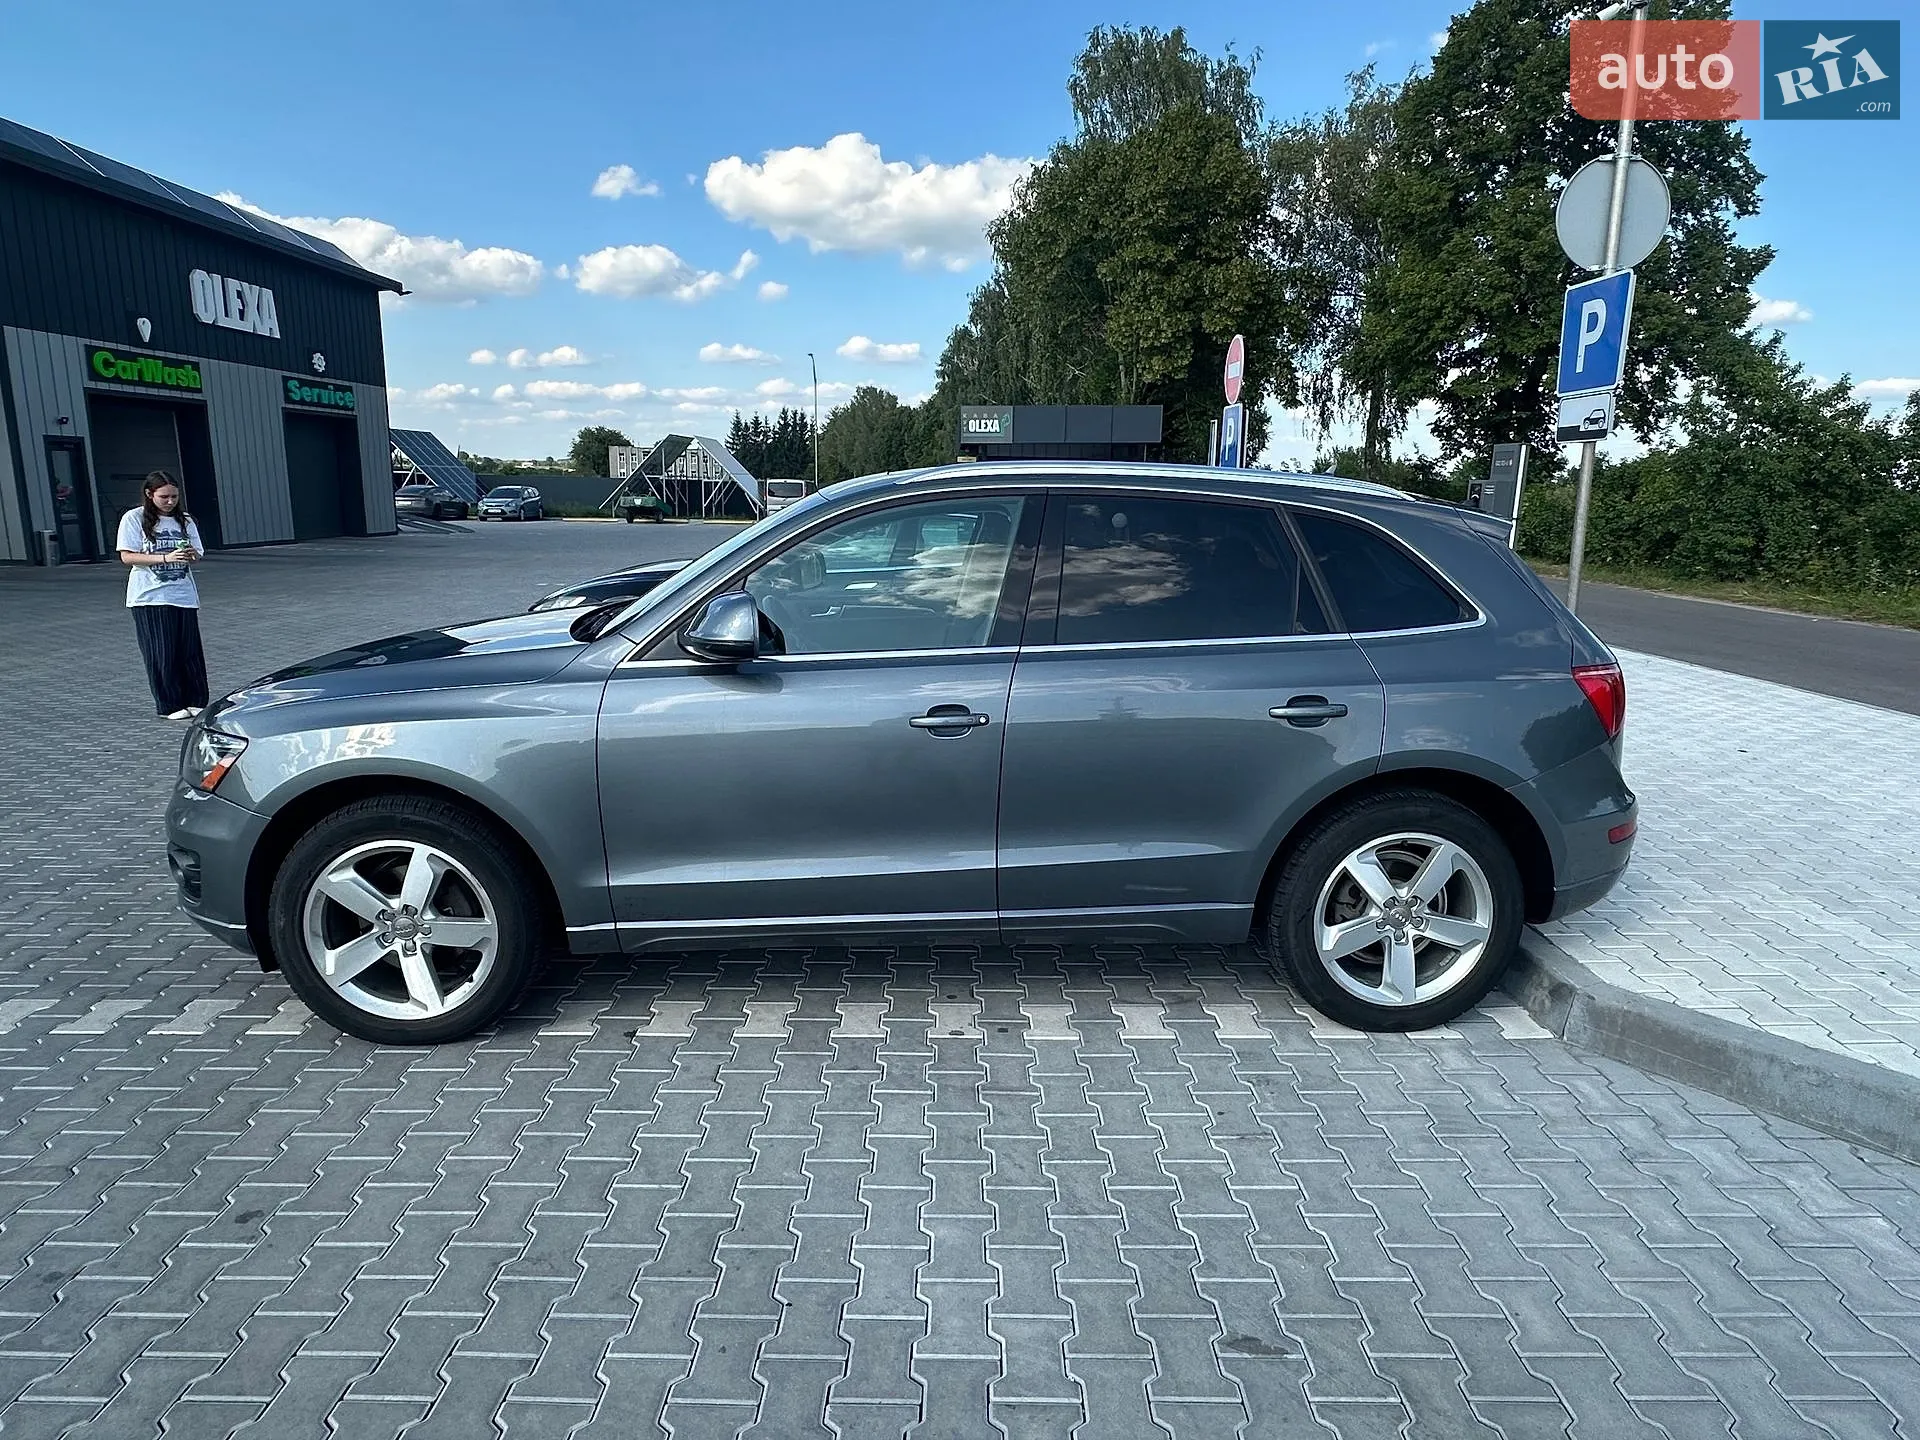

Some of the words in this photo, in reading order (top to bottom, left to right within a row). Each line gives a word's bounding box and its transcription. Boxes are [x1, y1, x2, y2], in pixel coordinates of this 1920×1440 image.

[189, 268, 281, 339] OLEXA
[1575, 298, 1607, 374] P
[93, 350, 202, 389] CarWash
[287, 379, 356, 409] Service
[968, 419, 1001, 433] OLEXA
[1225, 417, 1235, 461] P
